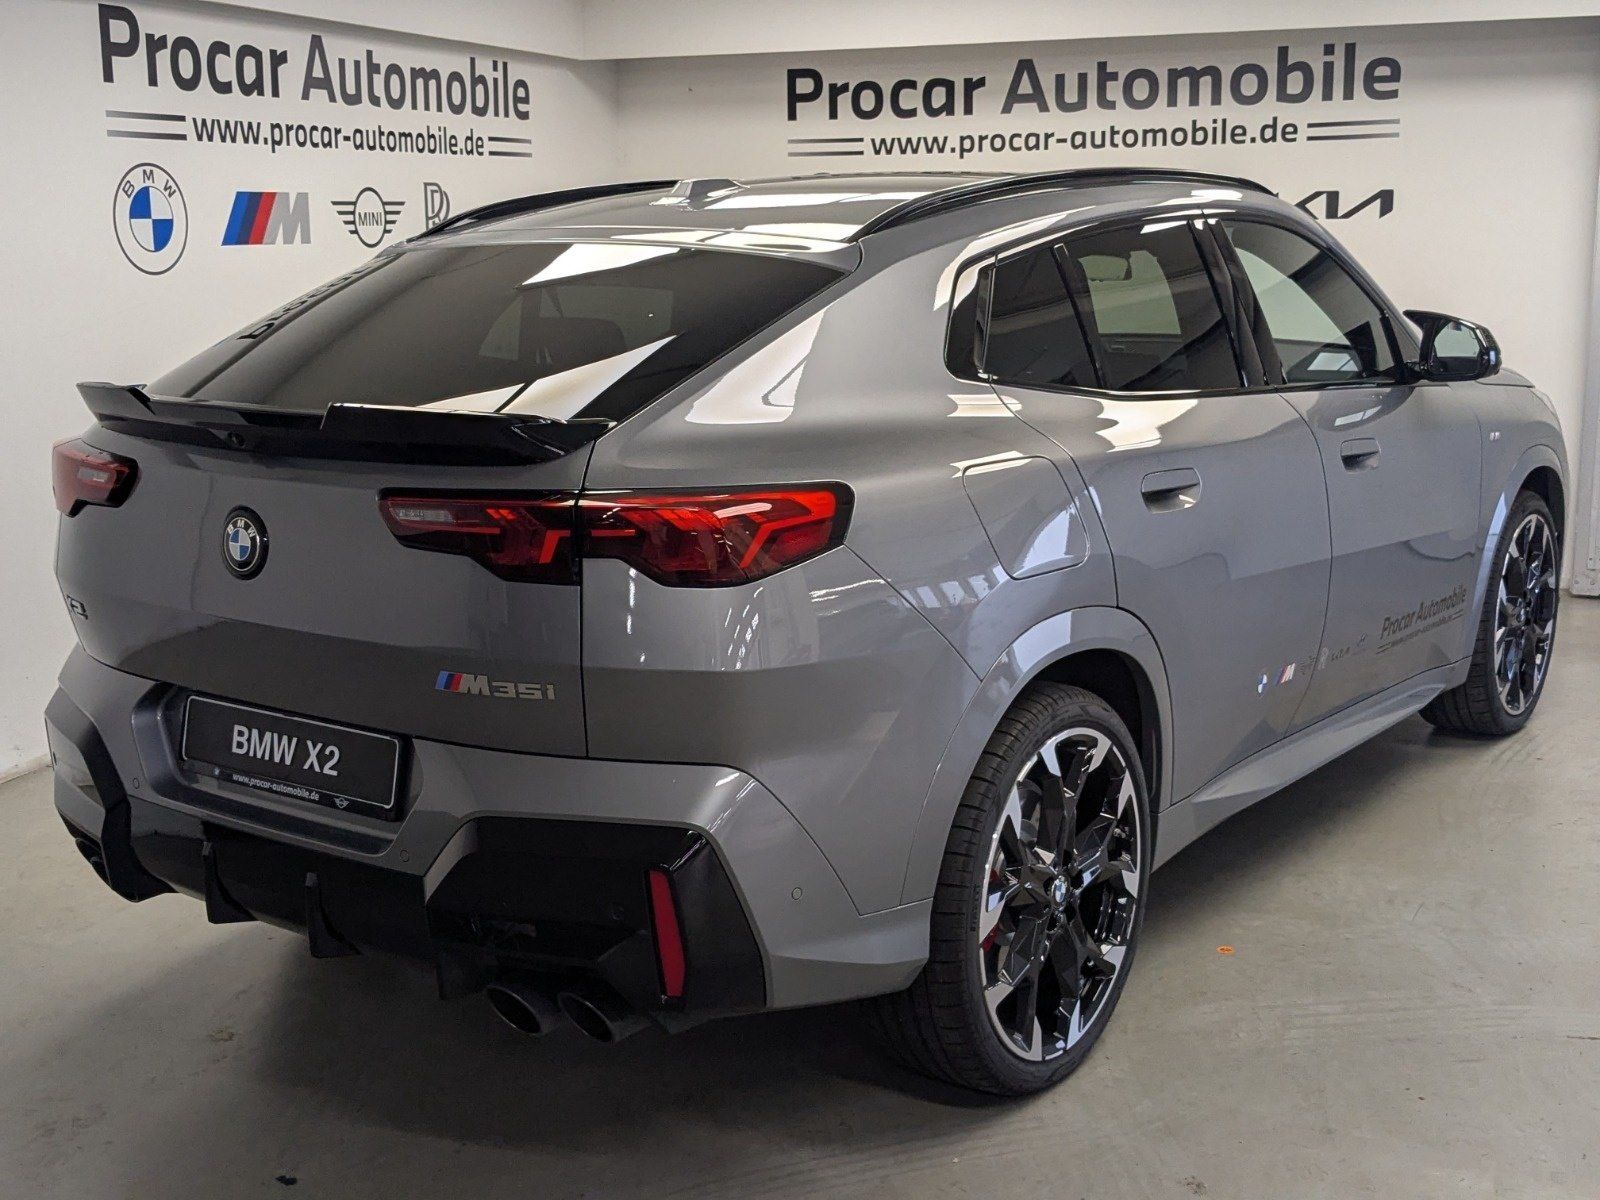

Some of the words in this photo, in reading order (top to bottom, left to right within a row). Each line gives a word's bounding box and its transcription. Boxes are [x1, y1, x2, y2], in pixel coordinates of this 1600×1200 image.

[98, 3, 288, 98] Procar
[301, 34, 530, 120] Automobile
[786, 68, 986, 121] Procar
[1000, 43, 1401, 115] Automobile
[192, 117, 485, 156] www.procar-automobile.de
[870, 117, 1299, 158] www.procar-automobile.de
[122, 169, 177, 199] BMW
[358, 211, 383, 227] MINI
[227, 519, 257, 538] BMW
[459, 673, 555, 700] M35i
[231, 724, 298, 766] BMW
[302, 739, 341, 777] X2
